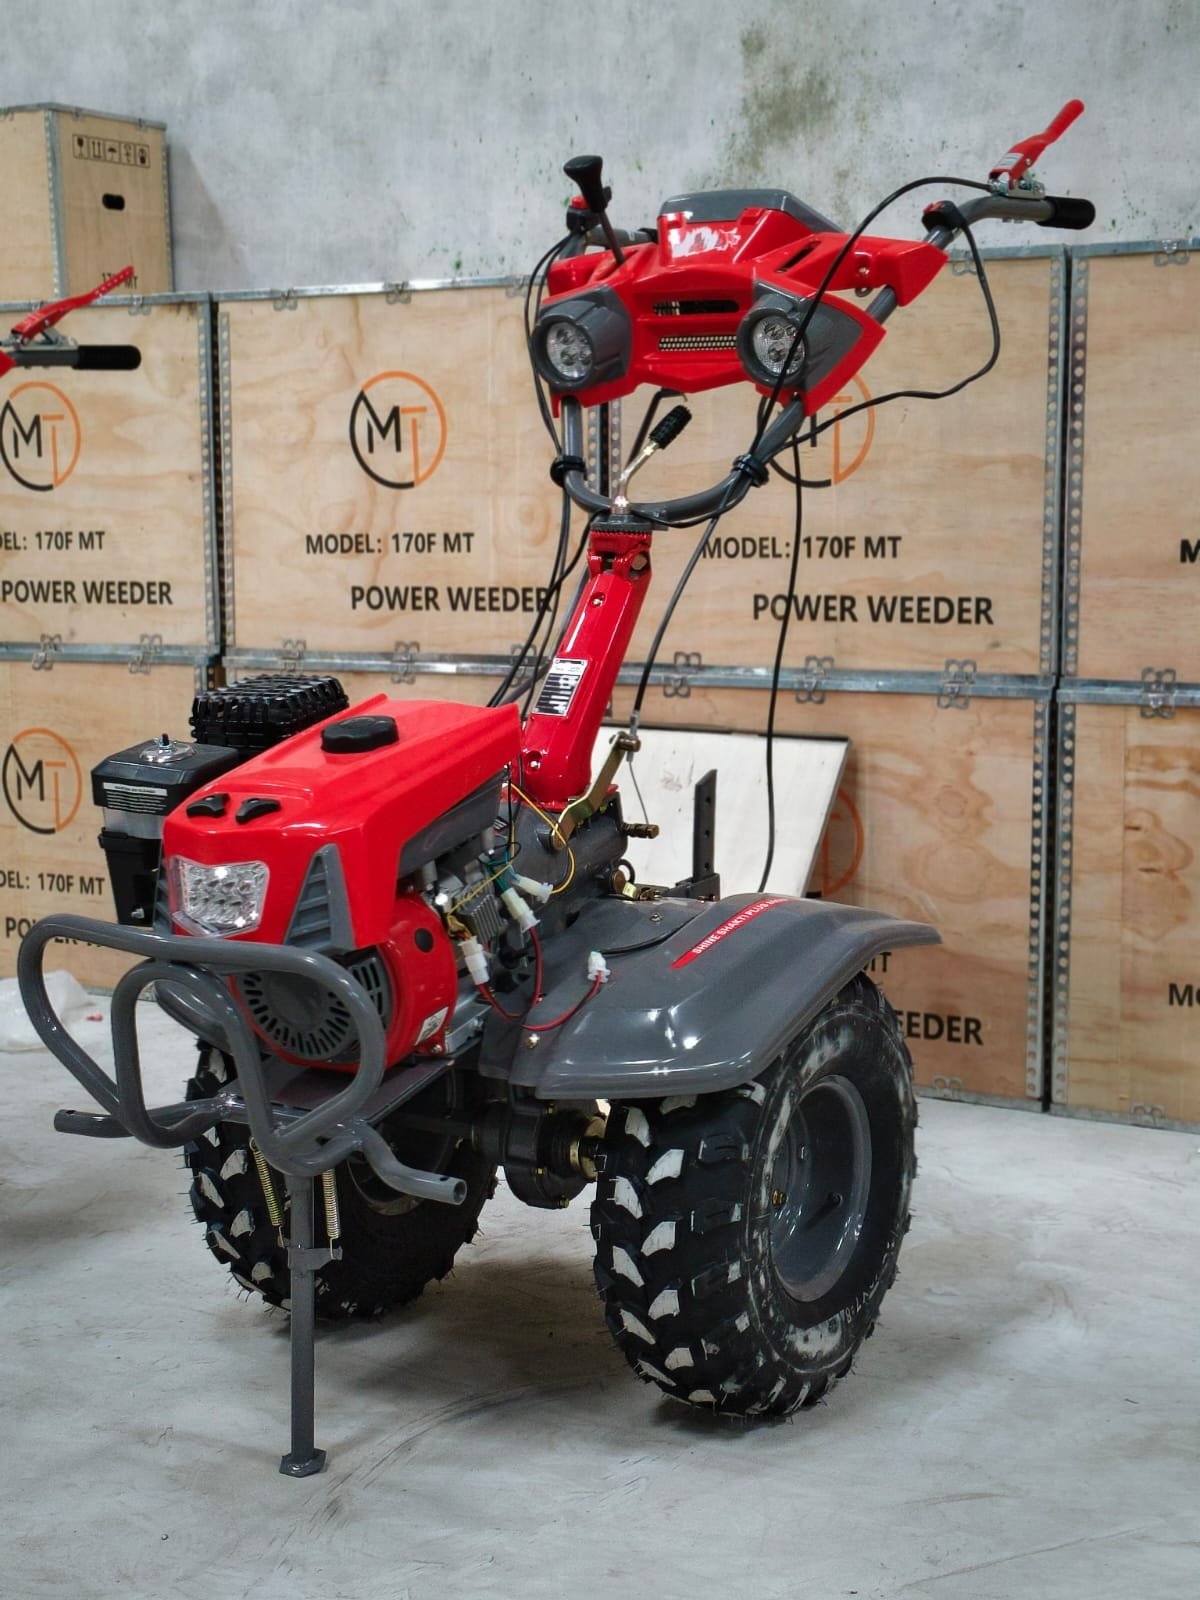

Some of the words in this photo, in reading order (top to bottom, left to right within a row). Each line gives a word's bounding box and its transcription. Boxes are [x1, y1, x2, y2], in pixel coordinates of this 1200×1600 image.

[35, 531, 73, 550] 170F
[79, 531, 105, 550] MT
[306, 534, 382, 554] MODEL:
[391, 533, 436, 553] 170F
[443, 532, 475, 553] MT
[702, 537, 791, 559] MODEL:
[803, 536, 856, 559] 170F
[864, 536, 902, 559] MT
[1, 580, 77, 604] POWER
[83, 580, 173, 605] WEEDER
[351, 586, 440, 611] POWER
[447, 587, 552, 612] WEEDER
[753, 594, 858, 623] POWER
[867, 595, 994, 625] WEEDER
[38, 872, 73, 893] 170F
[80, 876, 105, 895] MT
[692, 934, 720, 954] SHINE
